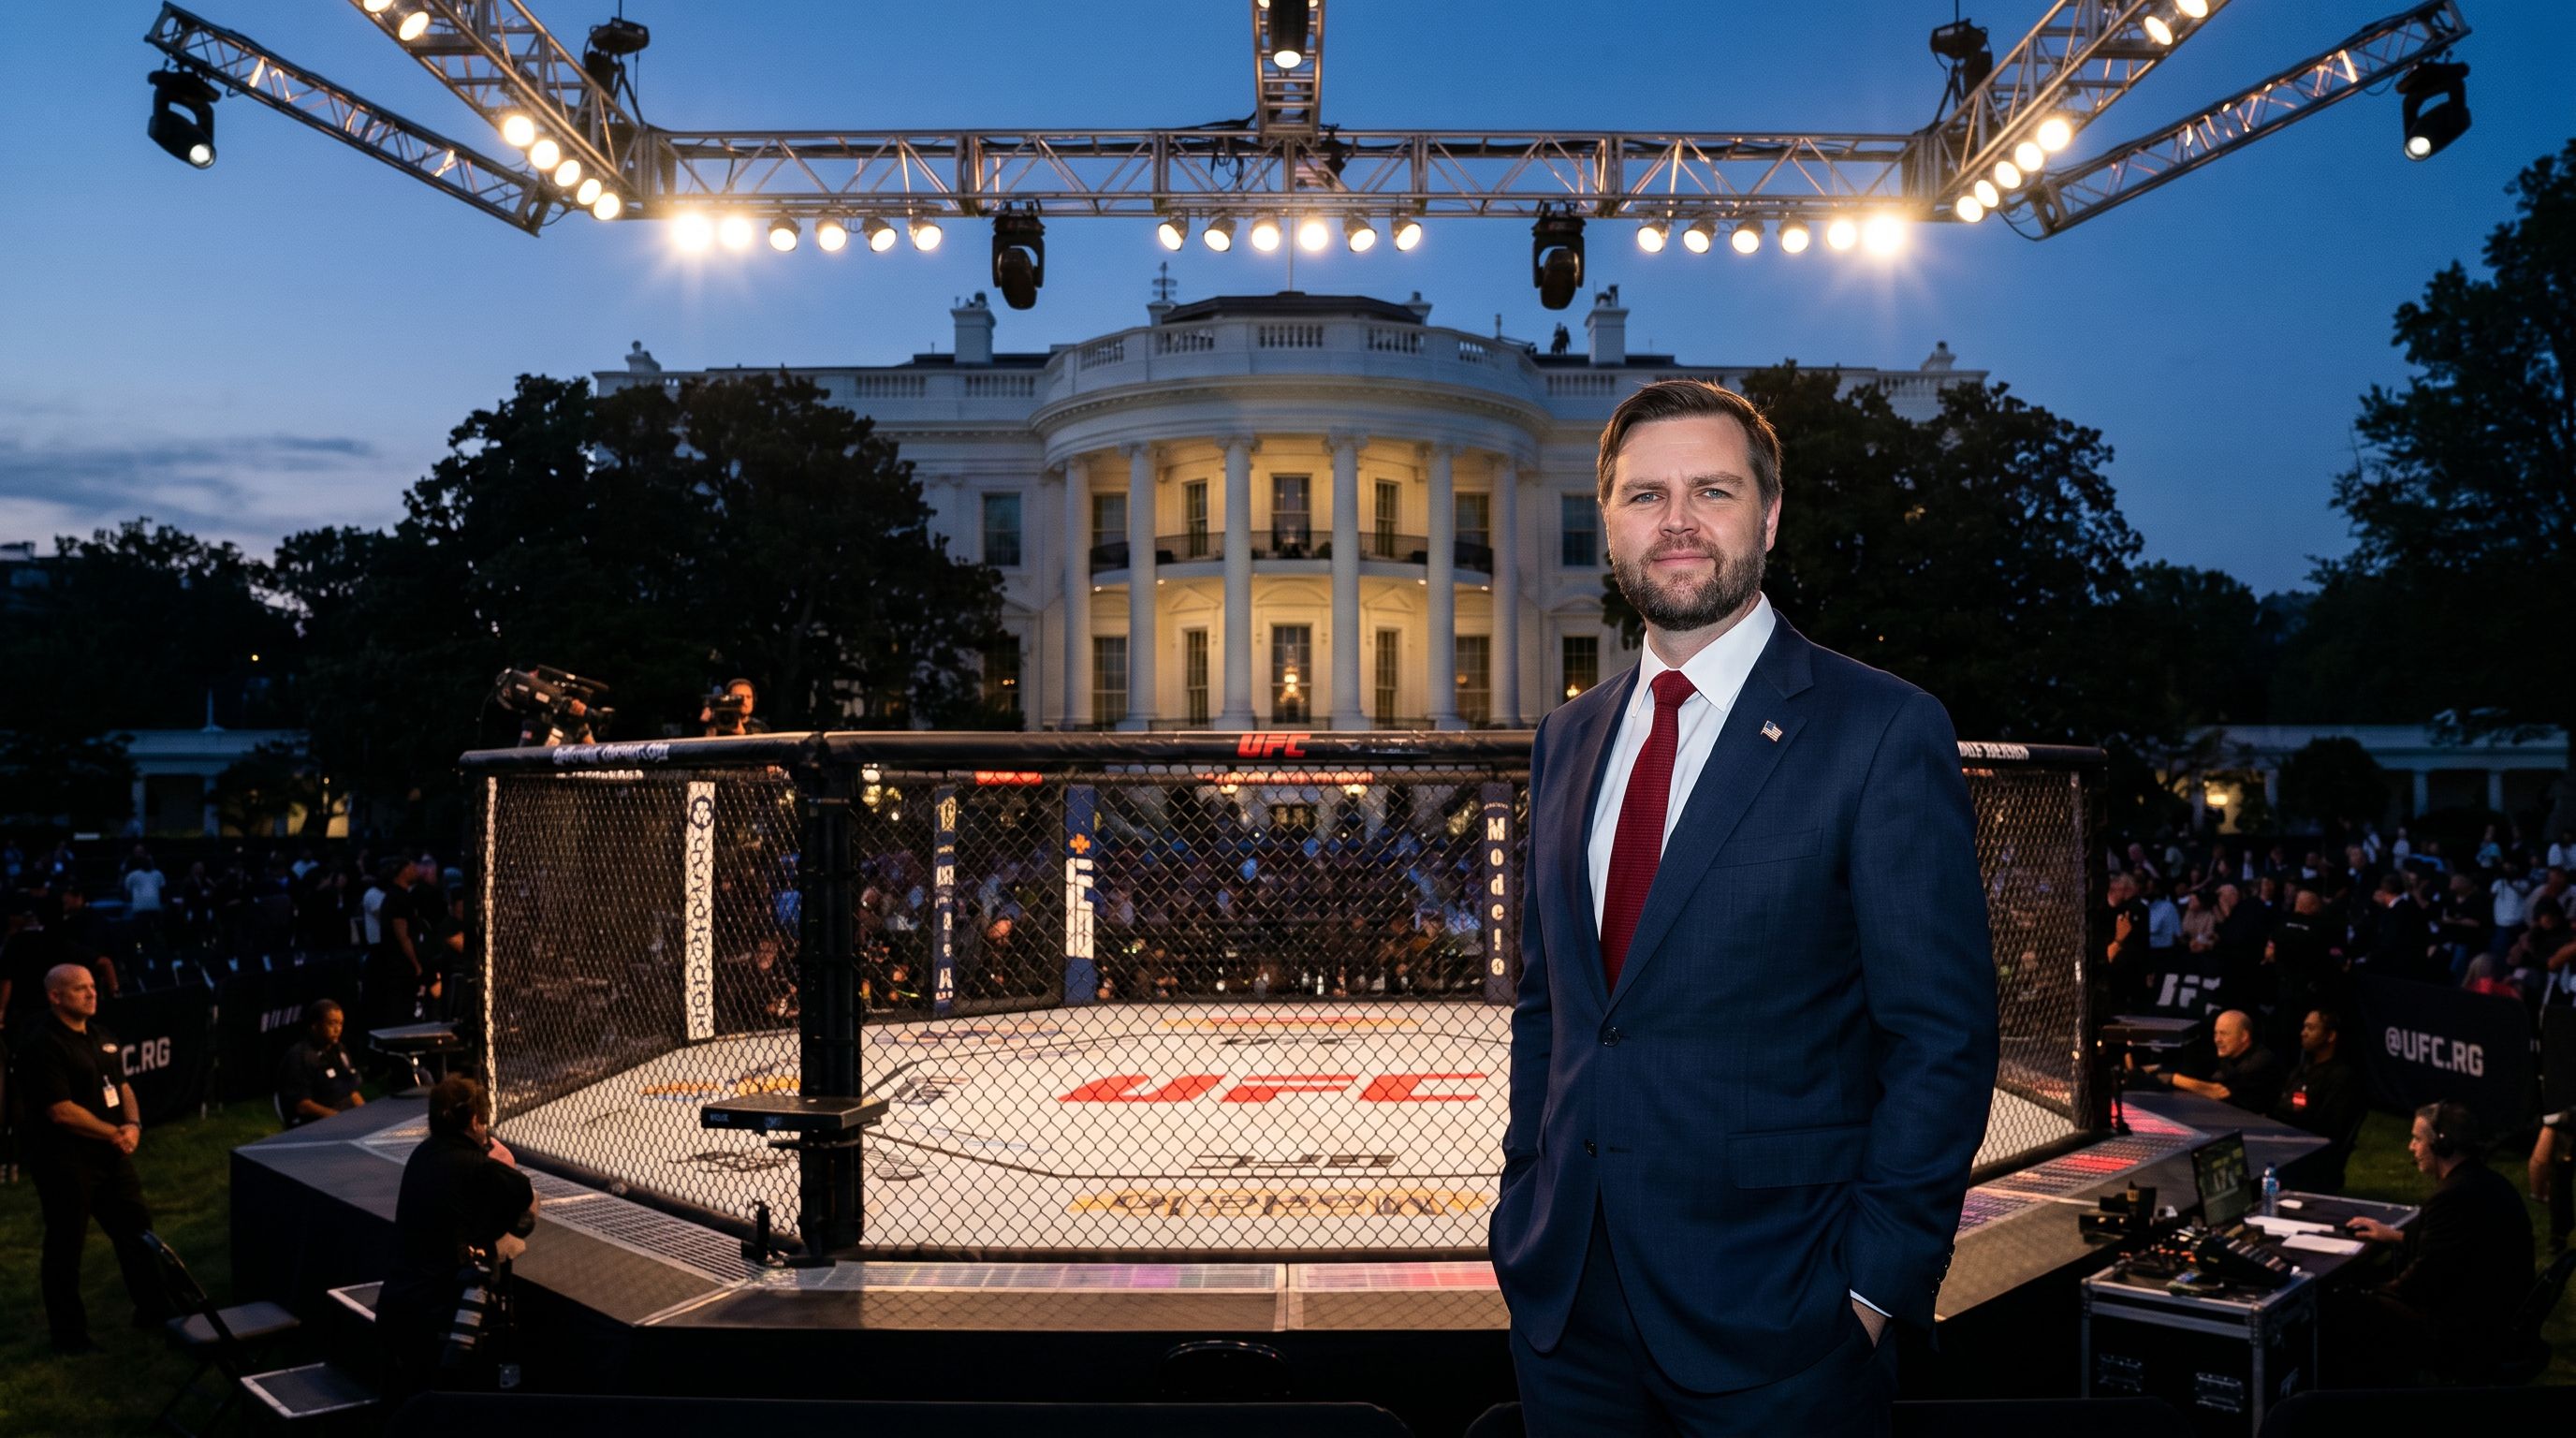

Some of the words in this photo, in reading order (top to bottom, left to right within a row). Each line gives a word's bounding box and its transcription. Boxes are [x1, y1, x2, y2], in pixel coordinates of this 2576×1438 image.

[1237, 734, 1310, 757] UFC
[2385, 1026, 2484, 1078] @UFC.RG
[1057, 1074, 1488, 1103] UFC
